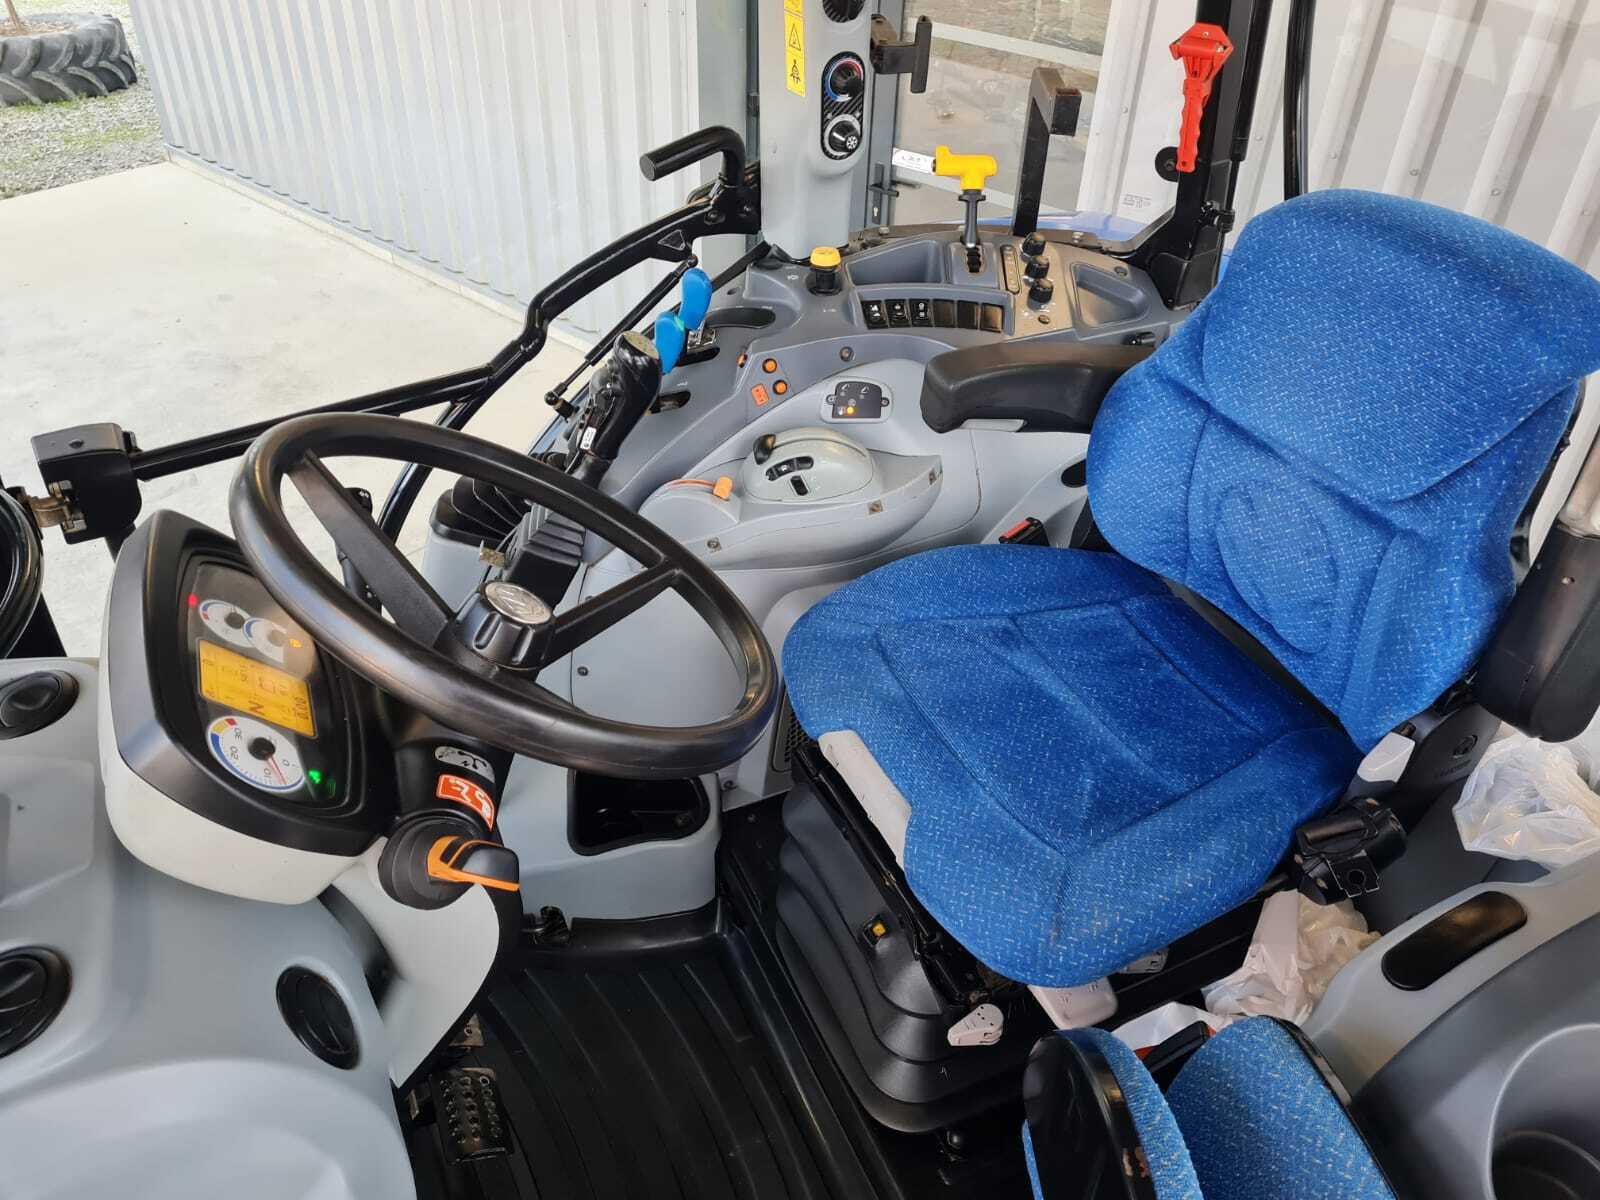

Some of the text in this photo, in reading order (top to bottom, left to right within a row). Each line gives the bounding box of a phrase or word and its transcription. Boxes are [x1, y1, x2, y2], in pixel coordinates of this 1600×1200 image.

[234, 727, 242, 740] 30
[230, 745, 239, 760] 20
[263, 767, 272, 778] 10
